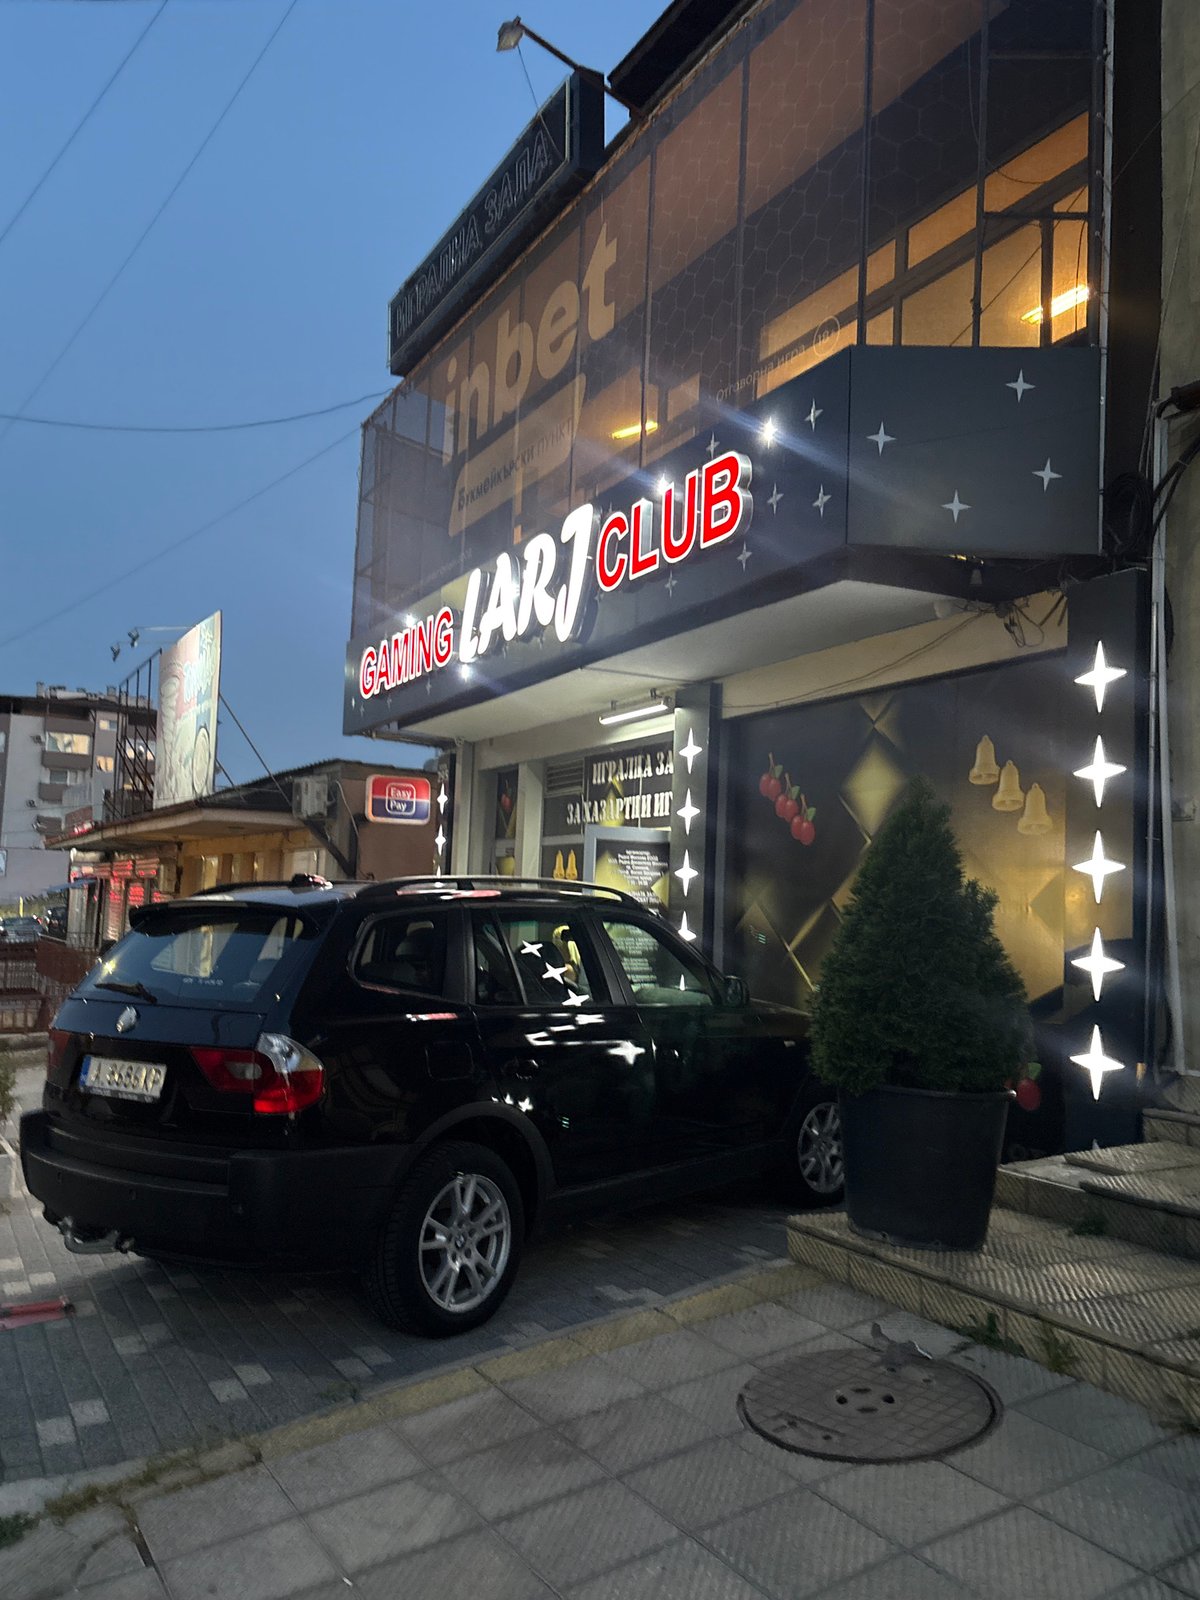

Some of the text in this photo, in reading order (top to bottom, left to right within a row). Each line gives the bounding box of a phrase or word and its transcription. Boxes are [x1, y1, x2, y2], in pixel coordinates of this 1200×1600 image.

[484, 129, 549, 233] ЗАЛА
[442, 222, 618, 467] inbet
[359, 606, 453, 700] GAMING
[458, 502, 595, 664] LARJ
[597, 450, 747, 592] CLUB
[592, 753, 653, 785] ИГРАЛНА
[390, 787, 411, 799] Easy
[390, 800, 407, 812] Pay
[566, 802, 581, 825] ЗА
[582, 793, 652, 823] ХАЗАРТНИ
